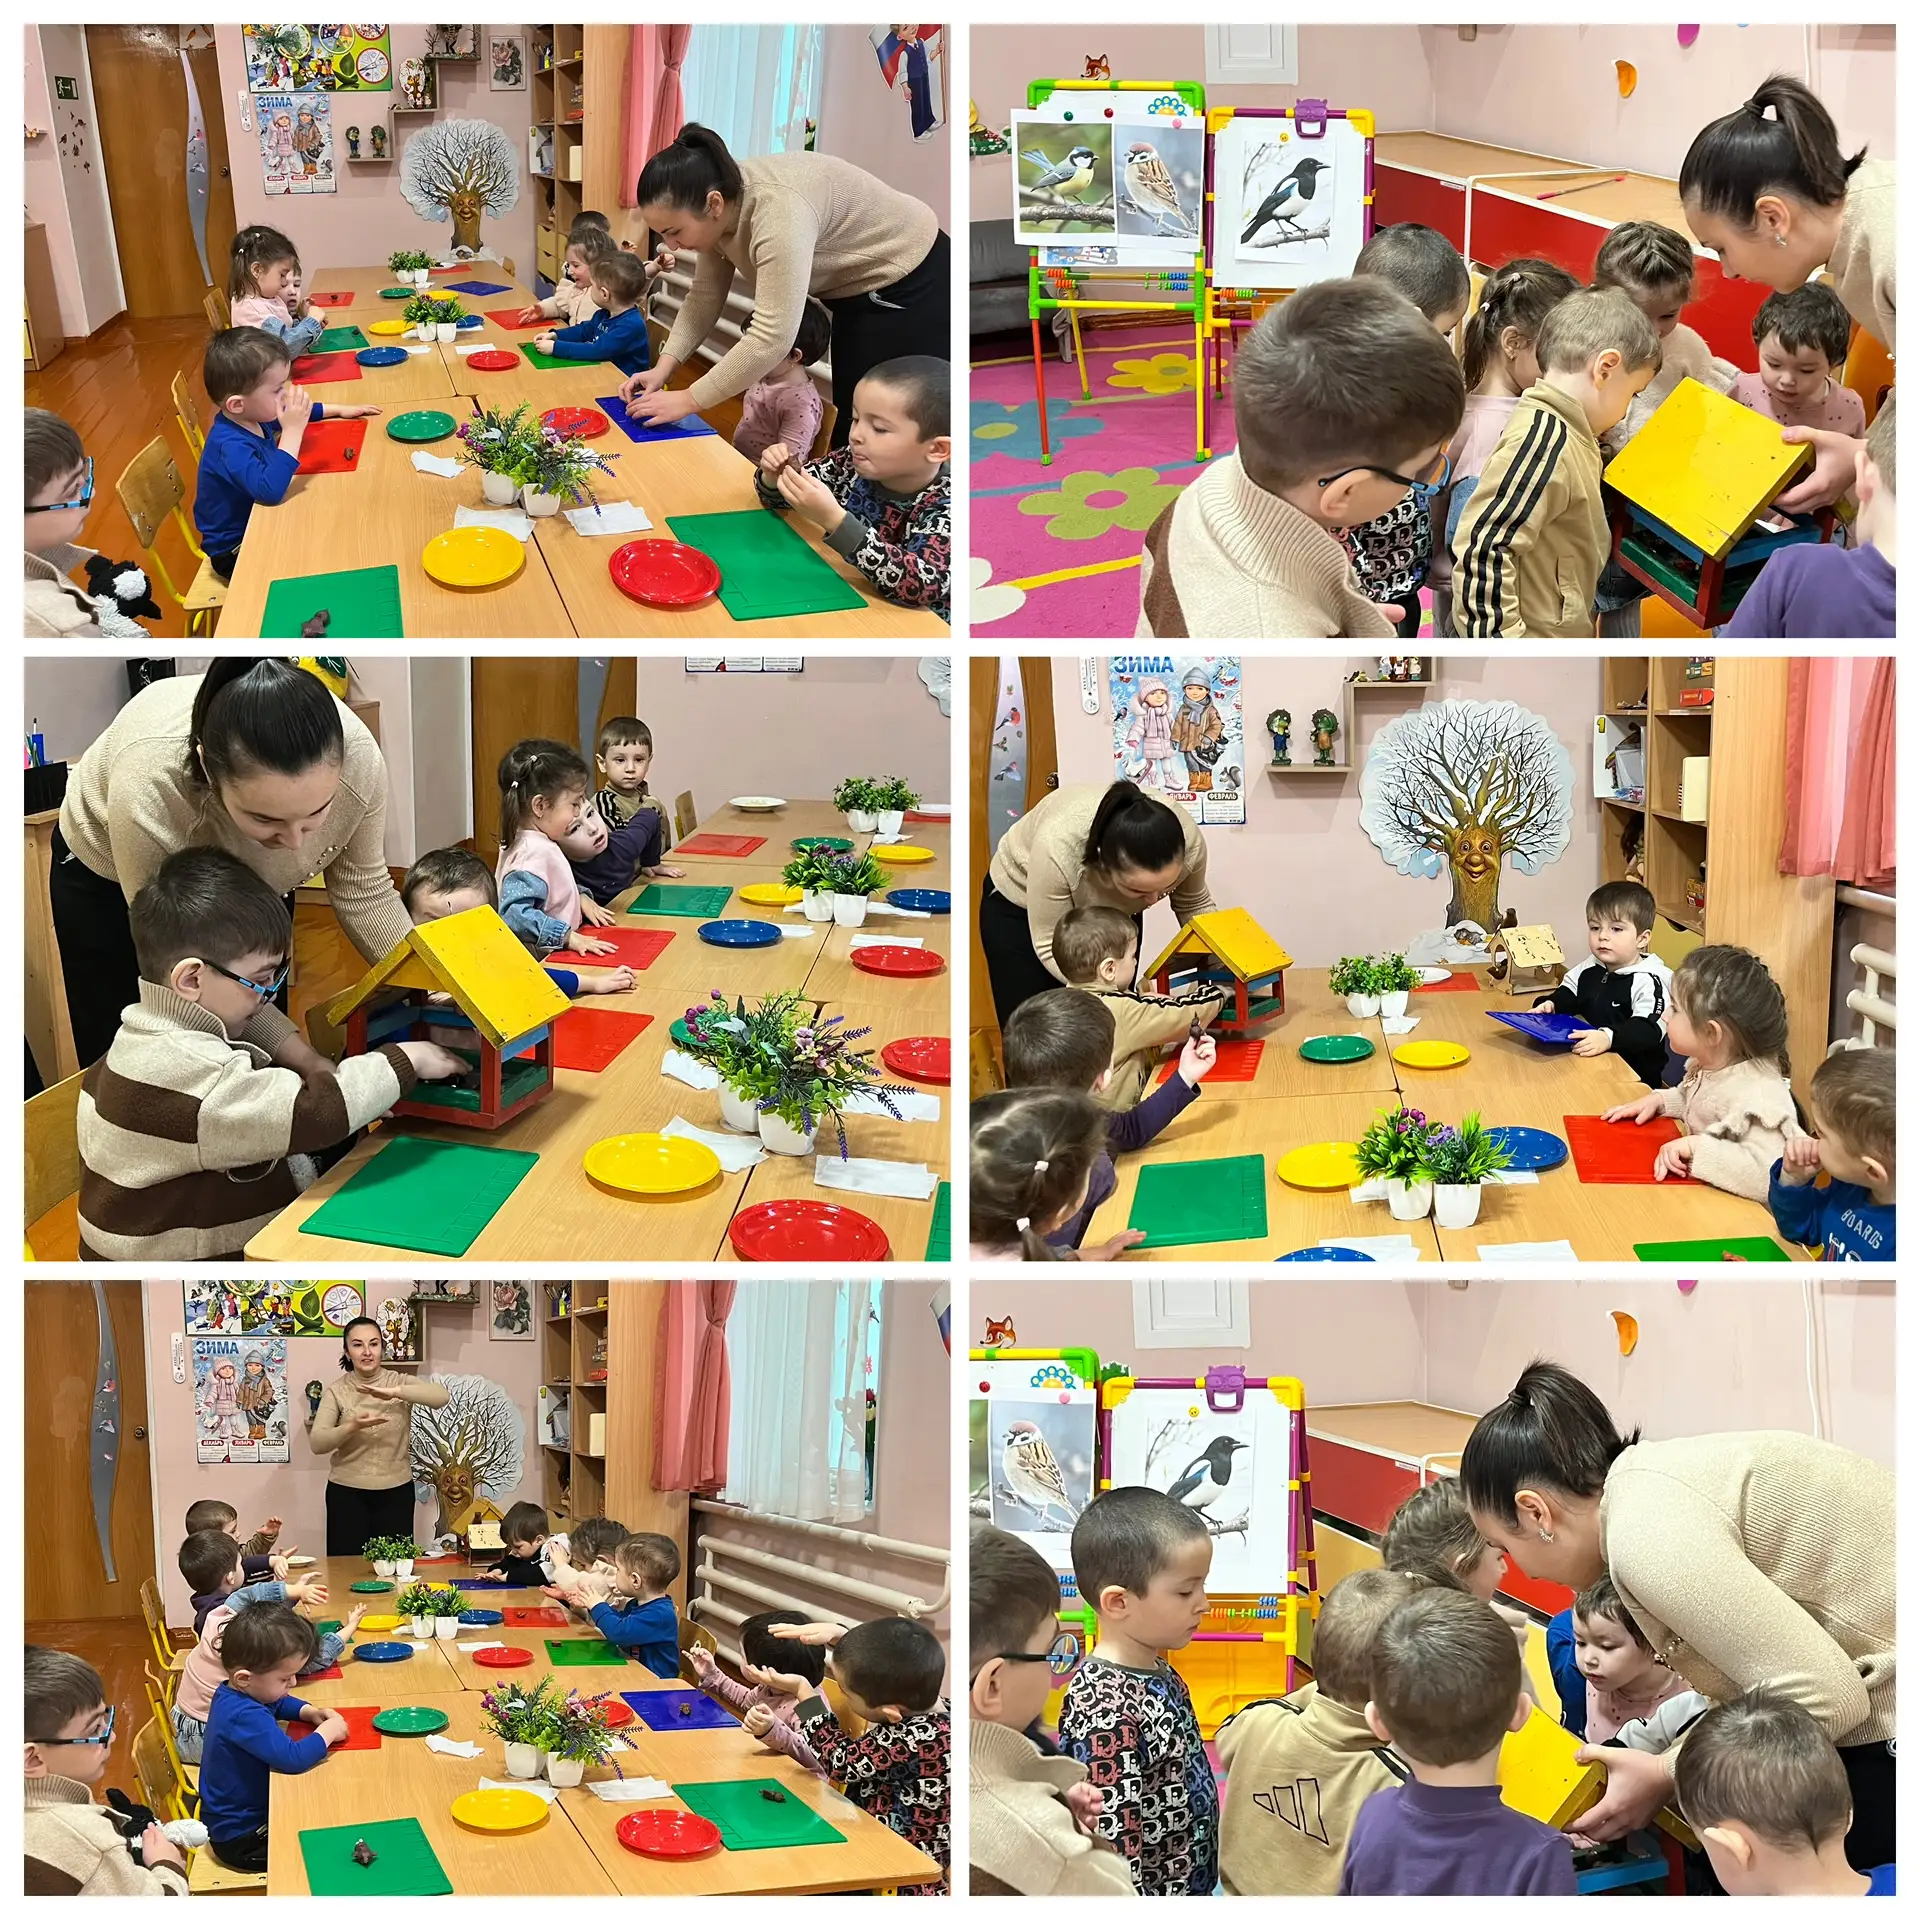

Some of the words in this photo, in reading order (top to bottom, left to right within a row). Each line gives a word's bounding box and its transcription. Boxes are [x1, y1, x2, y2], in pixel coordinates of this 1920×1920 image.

[258, 96, 293, 108] ЗИМА
[1114, 656, 1174, 673] ЗИМА
[1597, 717, 1606, 733] 1
[1208, 792, 1237, 800] ФЕВРАЛЬ
[1841, 1209, 1883, 1249] BOARDS
[196, 1340, 239, 1354] ЗИМА
